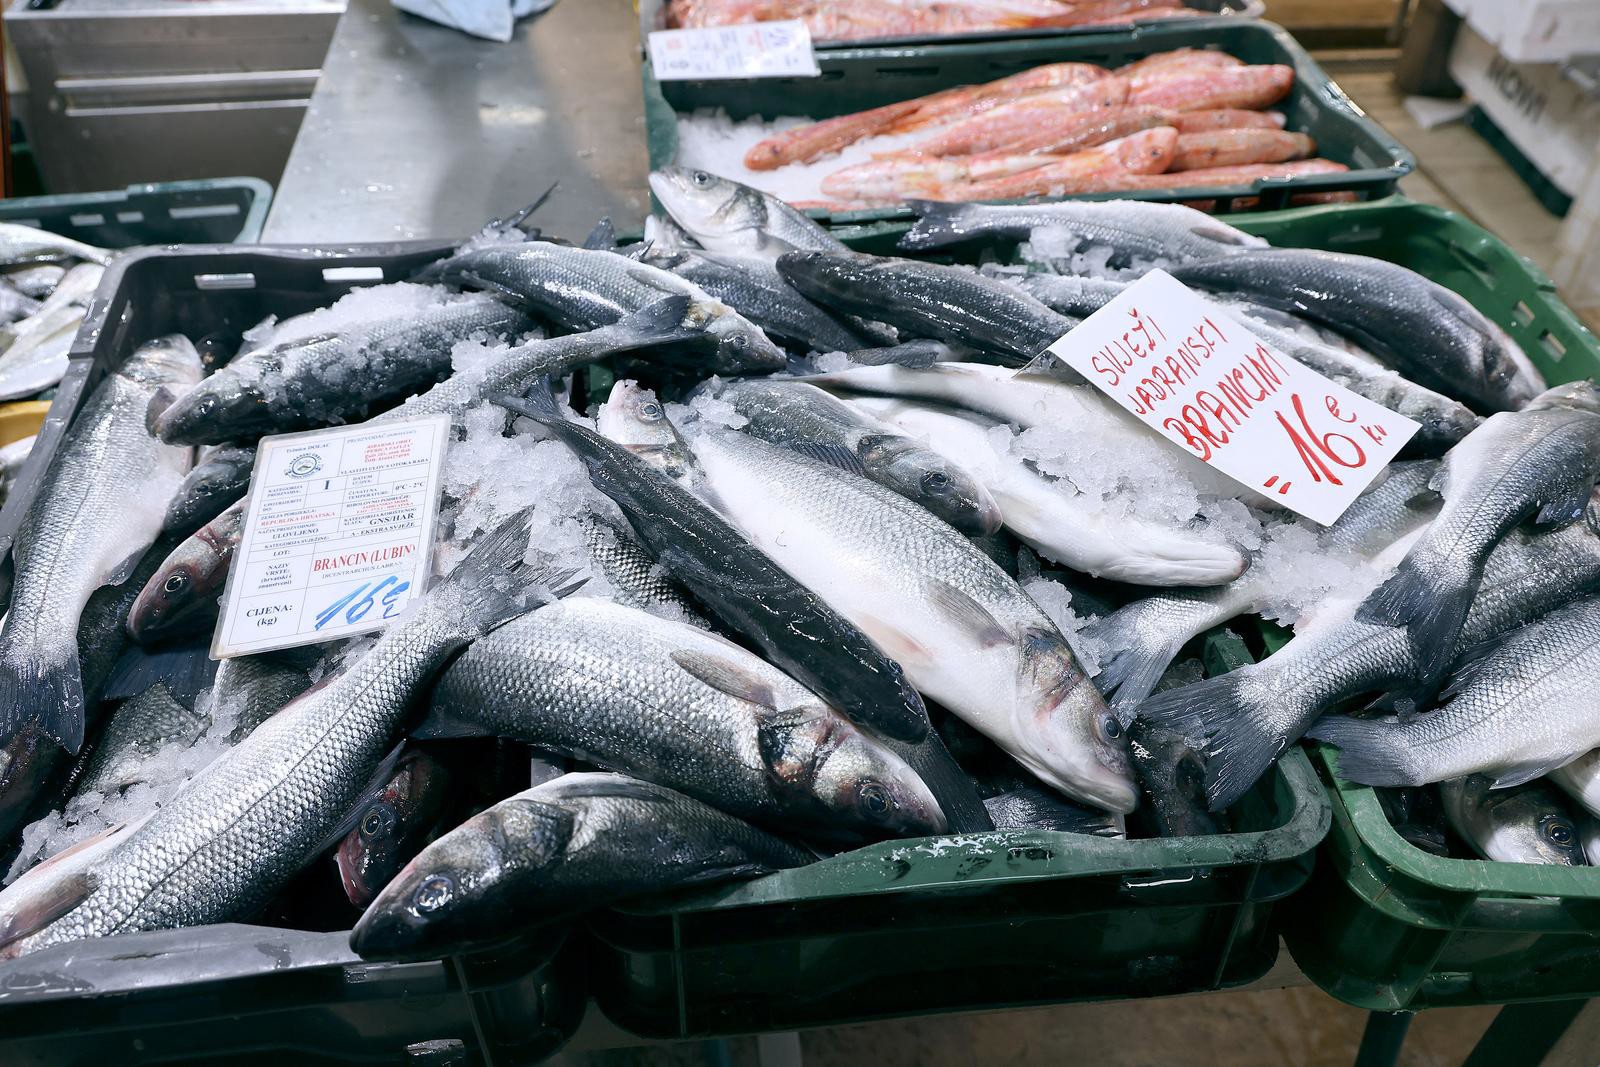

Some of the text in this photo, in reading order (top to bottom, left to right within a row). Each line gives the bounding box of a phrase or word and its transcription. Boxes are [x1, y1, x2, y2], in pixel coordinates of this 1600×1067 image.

[1127, 316, 1228, 415] JADRANSKI
[1274, 393, 1367, 486] 16
[261, 512, 335, 526] REPUBLIKA HRVATSKA
[369, 514, 414, 525] GNS/HAR
[272, 529, 318, 539] ULOVLJENO
[314, 552, 368, 571] BRANCIN
[246, 605, 293, 617] CIJENA:
[257, 617, 278, 627] (kg)
